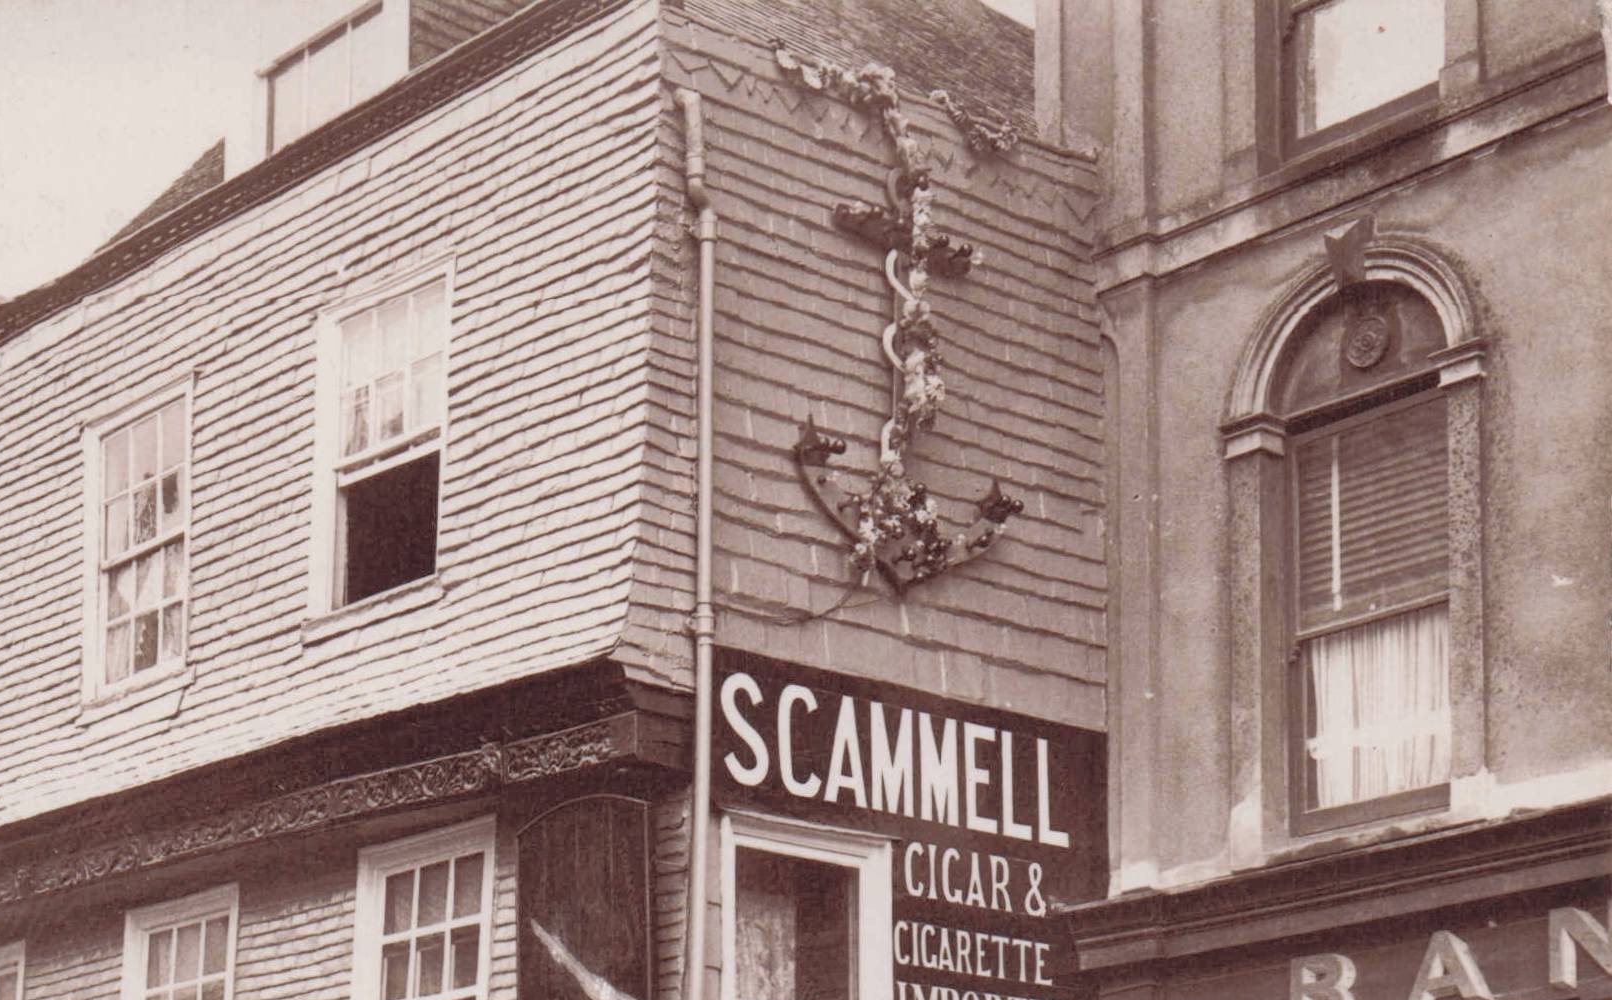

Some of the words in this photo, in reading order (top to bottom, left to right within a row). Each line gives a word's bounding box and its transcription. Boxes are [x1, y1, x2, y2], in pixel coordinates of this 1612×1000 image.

[720, 671, 1070, 849] SCAMMELL
[904, 841, 1012, 912] CIGAR
[1024, 862, 1048, 917] &
[894, 920, 1054, 987] CIGARETTE
